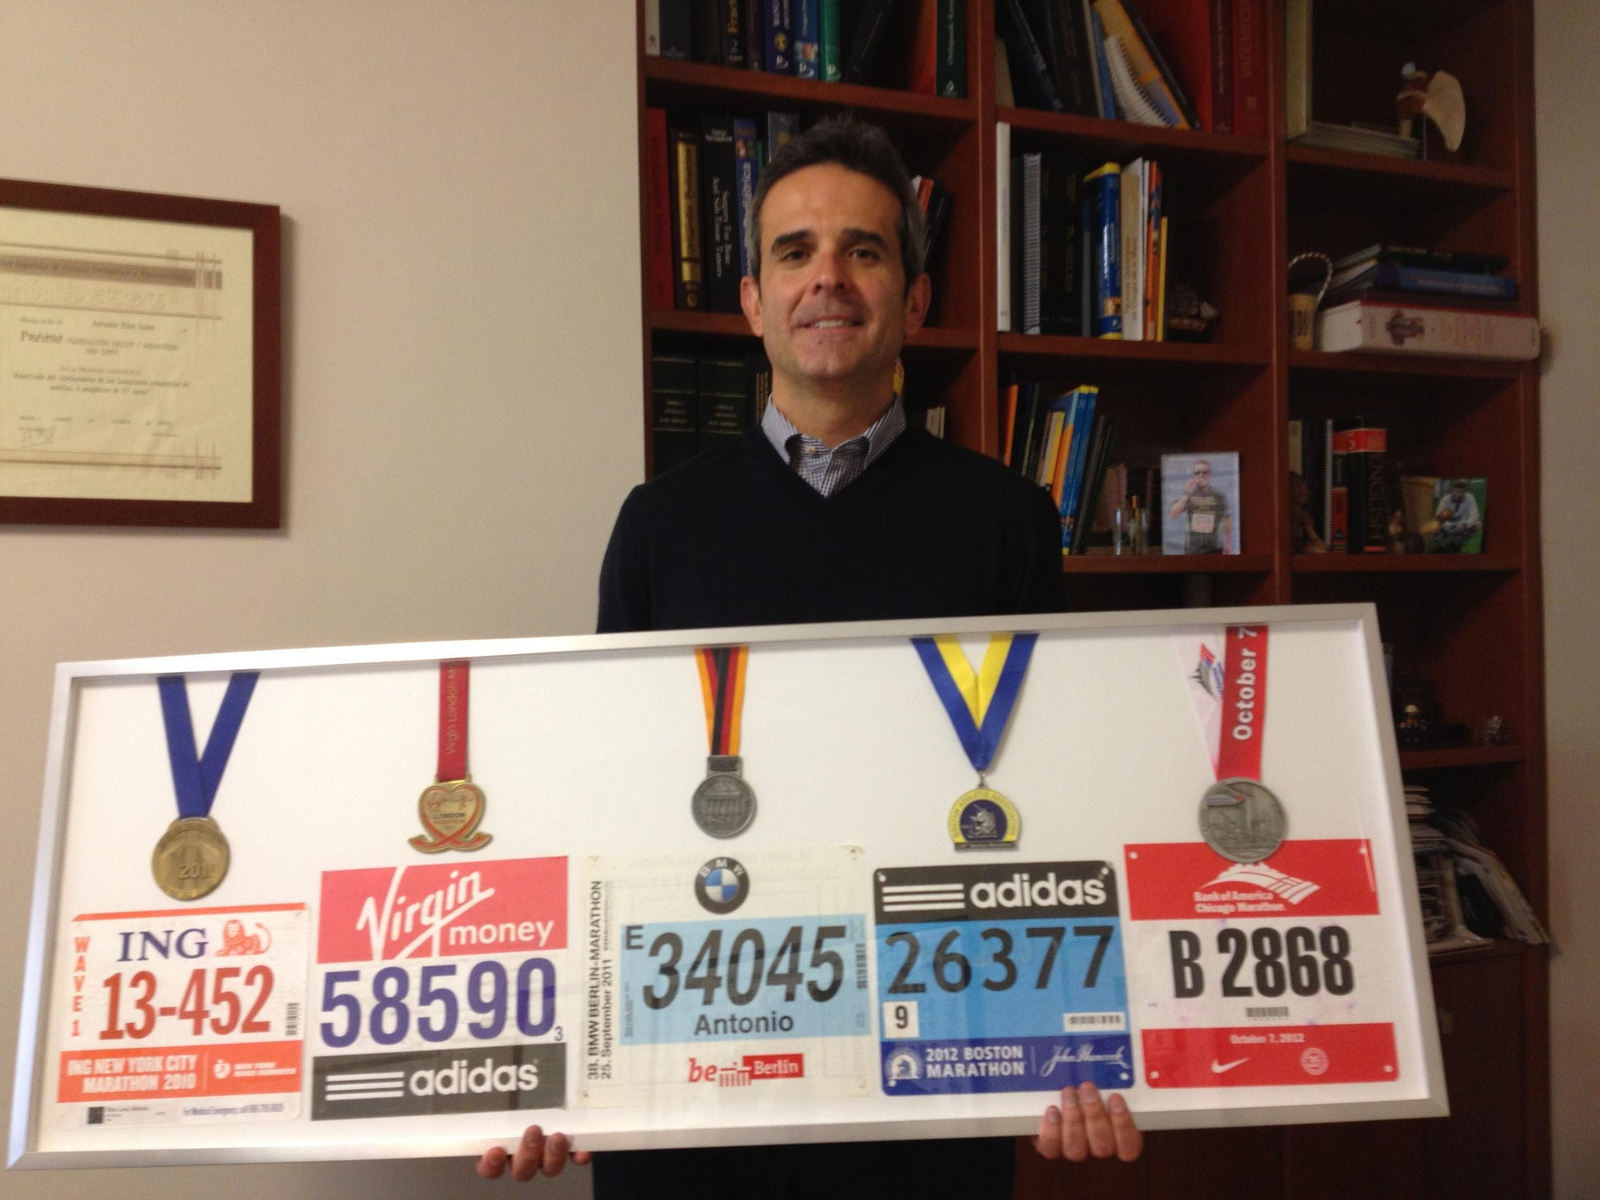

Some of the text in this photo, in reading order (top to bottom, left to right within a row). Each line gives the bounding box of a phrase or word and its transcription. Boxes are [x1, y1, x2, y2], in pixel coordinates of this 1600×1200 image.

[1231, 648, 1258, 741] October
[970, 873, 1107, 908] adidas
[356, 865, 495, 961] Virgin
[116, 928, 210, 962] ING
[449, 920, 554, 947] money
[72, 936, 92, 1012] WAVE
[601, 958, 613, 986] 2011
[625, 925, 644, 950] E
[643, 925, 847, 1011] 34045
[885, 925, 1114, 994] 26377
[1169, 926, 1355, 998] B 2868
[98, 965, 275, 1041] 13-452
[320, 957, 556, 1048] 58590
[895, 1005, 909, 1030] 9
[554, 1026, 564, 1042] 3
[588, 1021, 601, 1057] BMW
[601, 986, 614, 1058] September
[694, 1010, 794, 1036] Antonio
[67, 1054, 198, 1076] ING NEW YORK CITY
[587, 1058, 600, 1081] 38.
[601, 1058, 613, 1081] 25.
[688, 1058, 799, 1083] be Berlin
[926, 1046, 1023, 1061] 2012 BOSTON
[926, 1061, 1025, 1078] MARATHON
[82, 1074, 159, 1093] MARATHON
[410, 1058, 539, 1096] adidas
